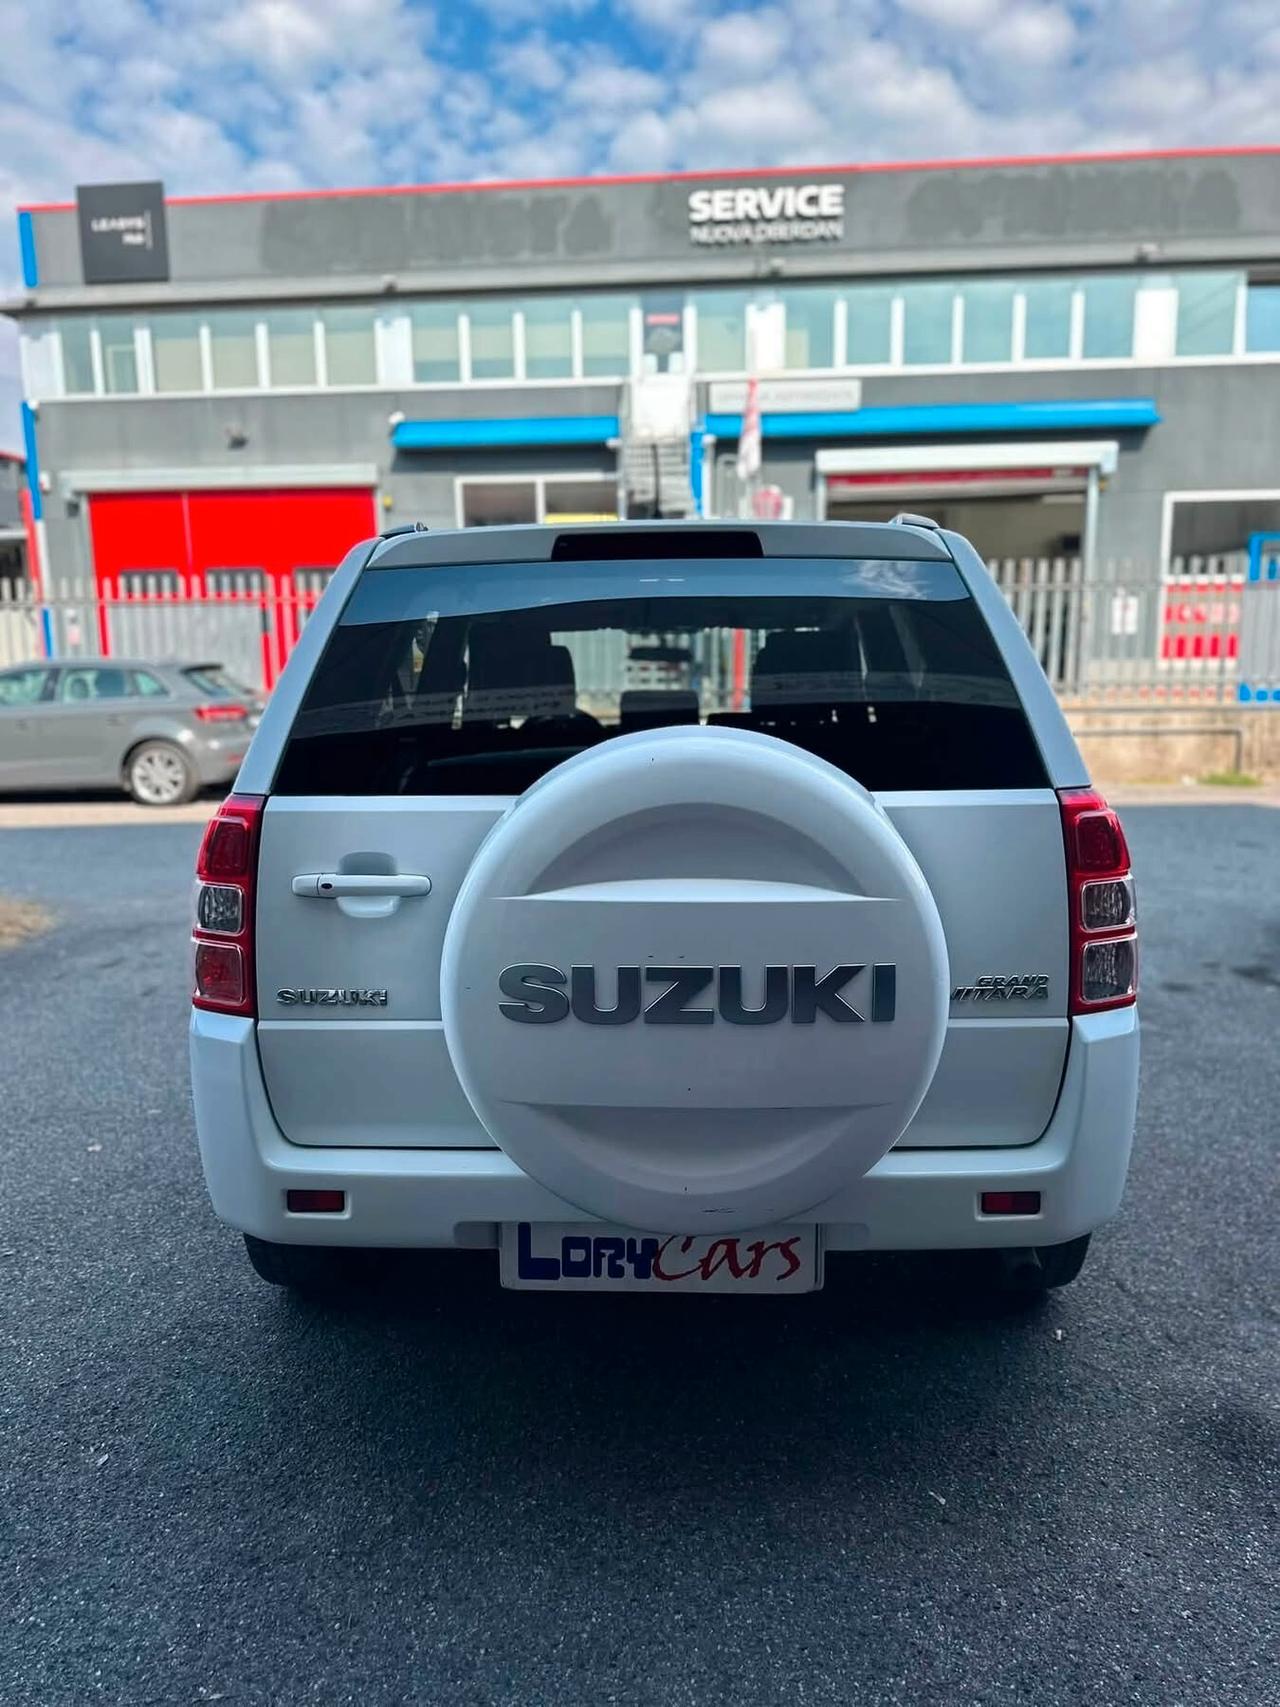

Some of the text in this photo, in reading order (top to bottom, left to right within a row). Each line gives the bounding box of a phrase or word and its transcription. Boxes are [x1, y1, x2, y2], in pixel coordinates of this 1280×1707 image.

[688, 184, 844, 222] SERVICE
[498, 962, 897, 1025] SUZUKI
[977, 974, 1049, 987] GRAND
[276, 988, 388, 1007] SUZUKI
